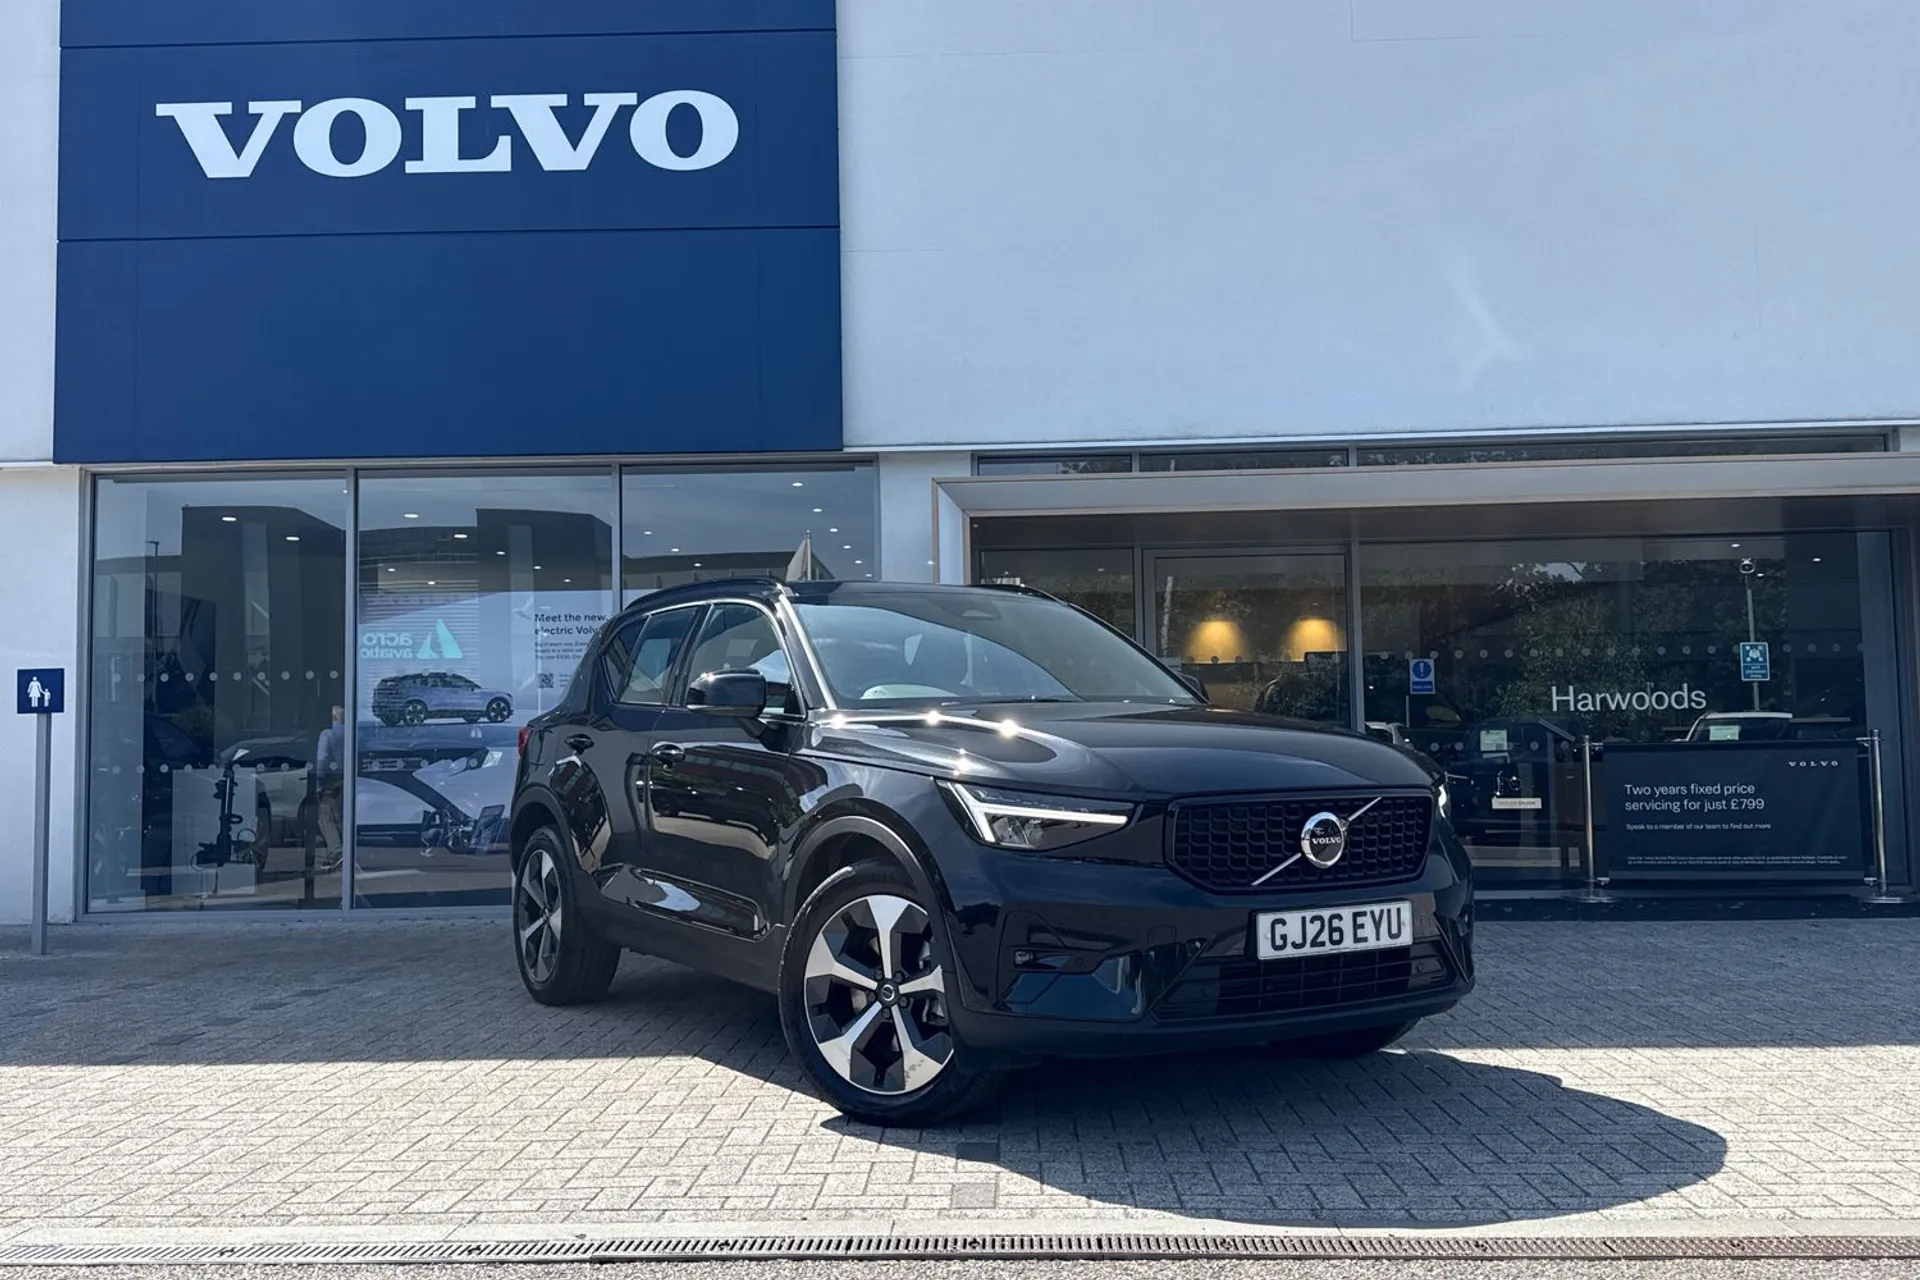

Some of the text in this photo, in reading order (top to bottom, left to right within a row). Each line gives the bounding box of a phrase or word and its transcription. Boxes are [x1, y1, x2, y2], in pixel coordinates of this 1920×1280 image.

[156, 89, 739, 178] VOLVO
[534, 613, 562, 622] Meet
[564, 612, 581, 622] the
[534, 625, 598, 635] electric Volv
[1552, 683, 1707, 712] Harwoods
[1624, 783, 1755, 797] Two years fixed price
[1624, 798, 1765, 813] servicing for just £799
[1646, 823, 1653, 831] to
[1659, 823, 1684, 831] member
[1686, 823, 1693, 831] of
[1694, 823, 1704, 831] our
[1705, 823, 1721, 831] team
[1722, 823, 1729, 831] to
[1730, 823, 1742, 831] find
[1744, 823, 1753, 831] out
[1755, 823, 1771, 831] more
[1312, 836, 1341, 844] VOLVO
[1270, 907, 1402, 951] GJ26 EYU
